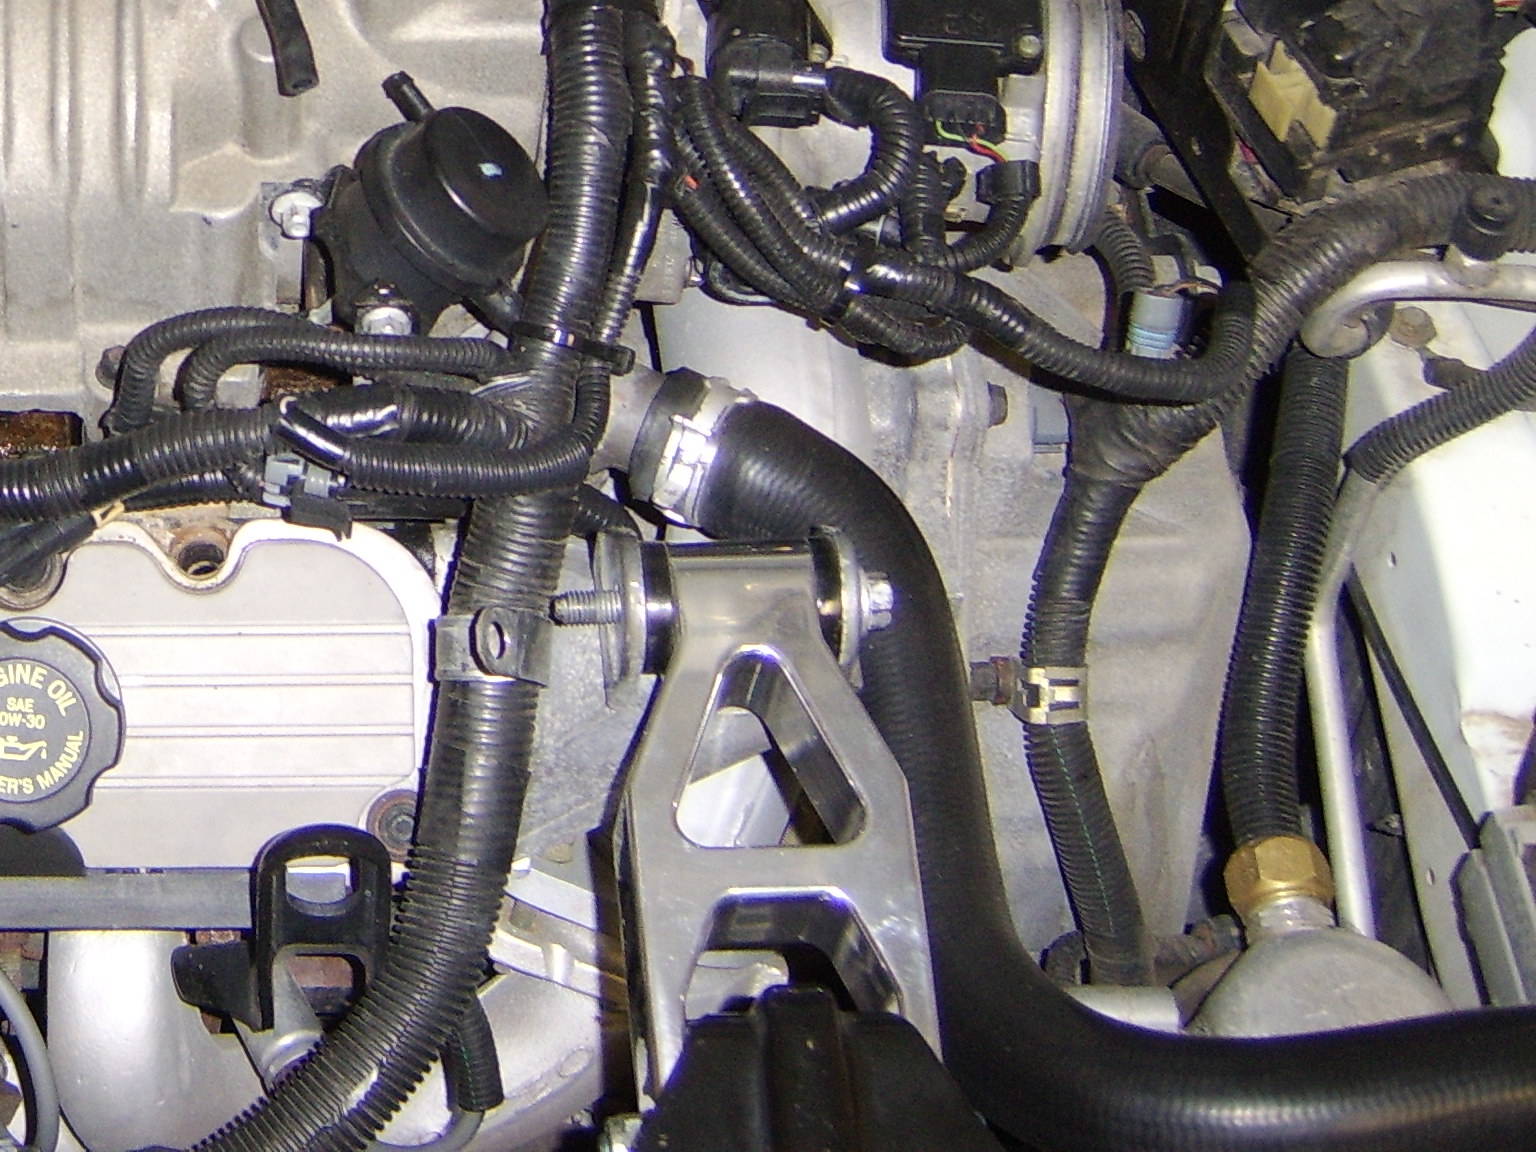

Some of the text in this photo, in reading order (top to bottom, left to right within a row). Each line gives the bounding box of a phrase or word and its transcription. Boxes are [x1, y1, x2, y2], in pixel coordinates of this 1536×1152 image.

[7, 697, 35, 711] SAE
[47, 679, 77, 717] OIL
[38, 730, 85, 791] MANUAL
